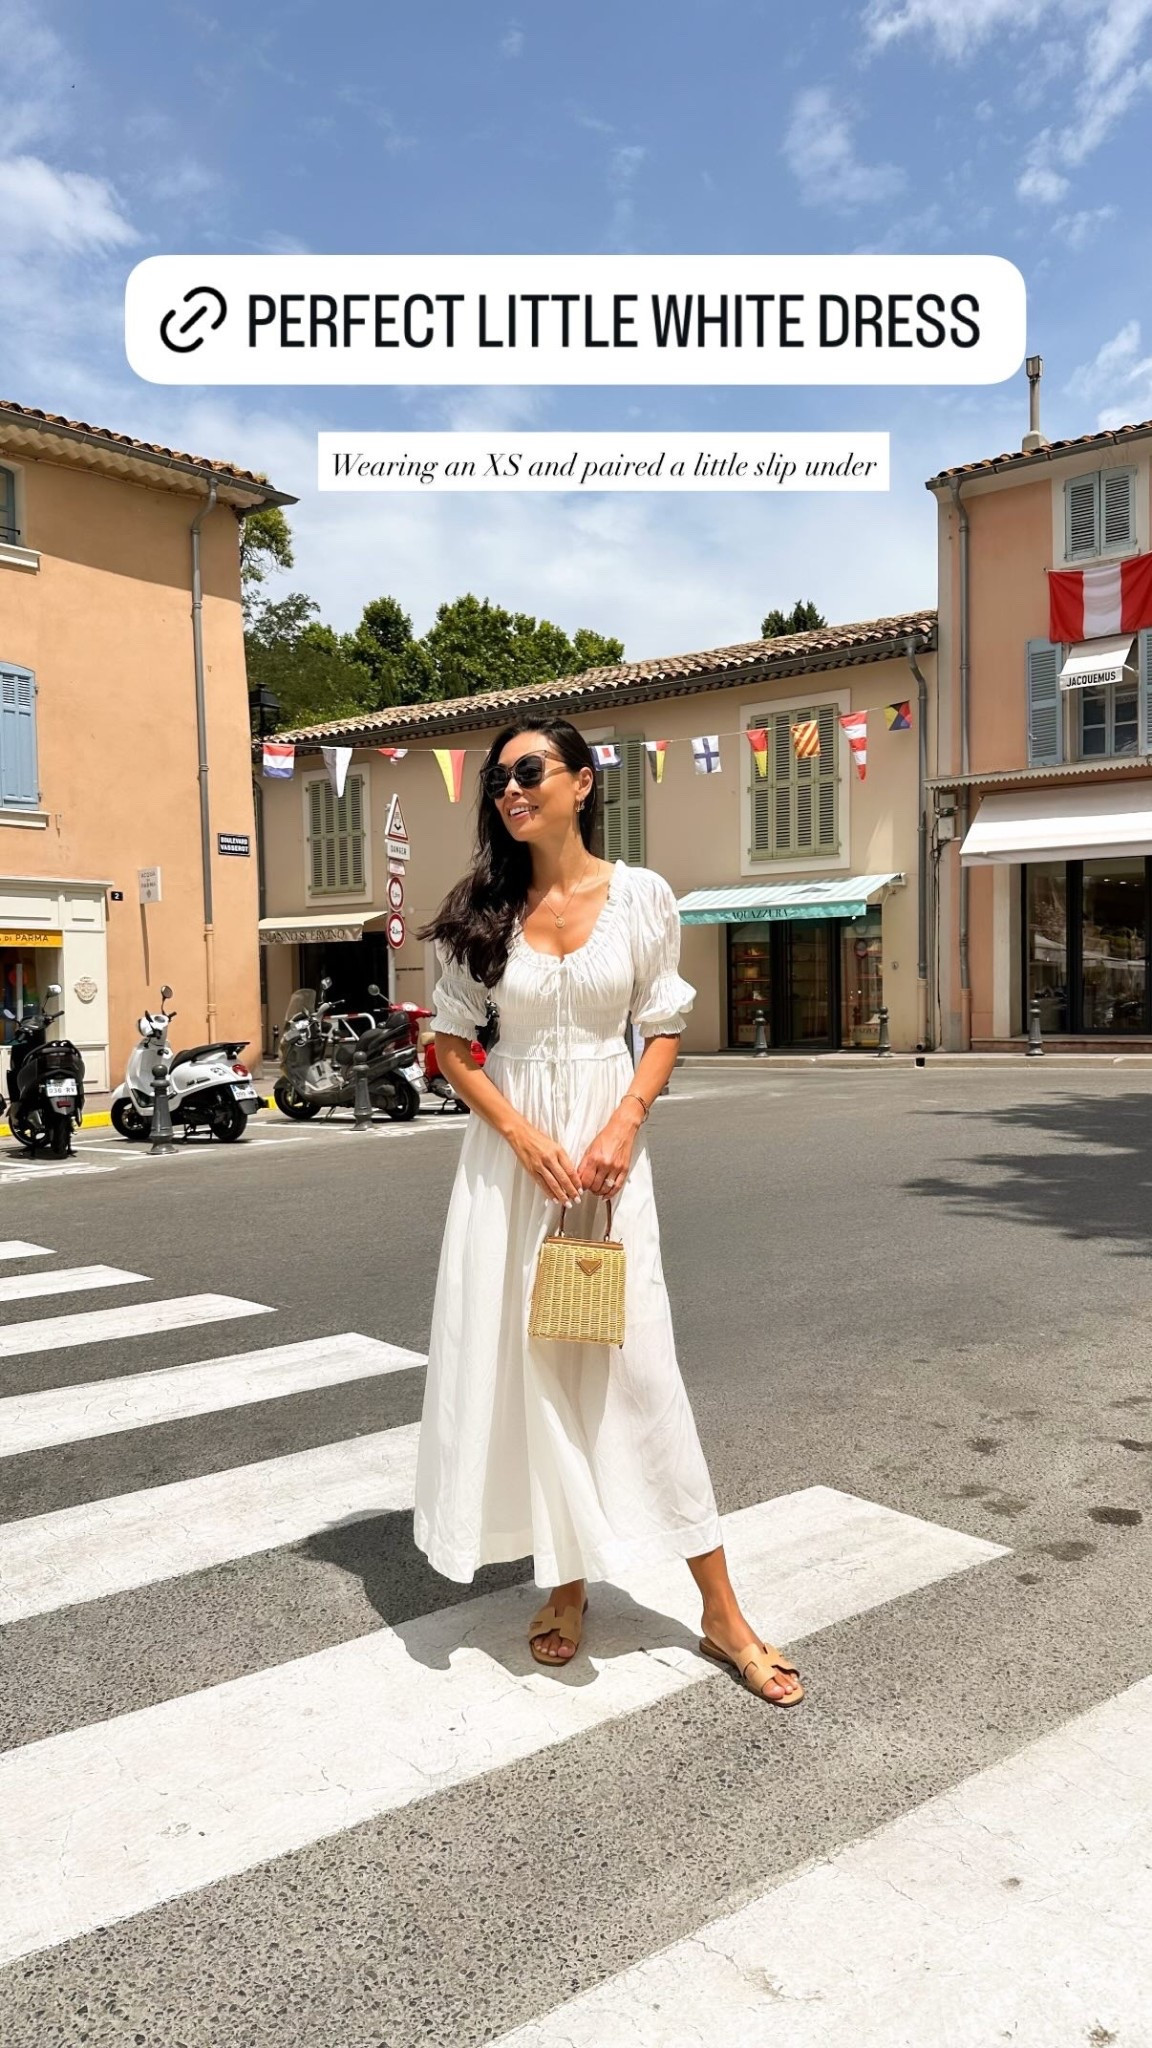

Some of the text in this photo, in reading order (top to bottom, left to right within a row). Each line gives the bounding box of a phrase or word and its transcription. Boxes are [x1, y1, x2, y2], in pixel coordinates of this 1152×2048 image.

[1066, 671, 1116, 687] JACQUEMUS
[732, 908, 788, 920] AQUAZZURA
[15, 933, 49, 941] PARMA
